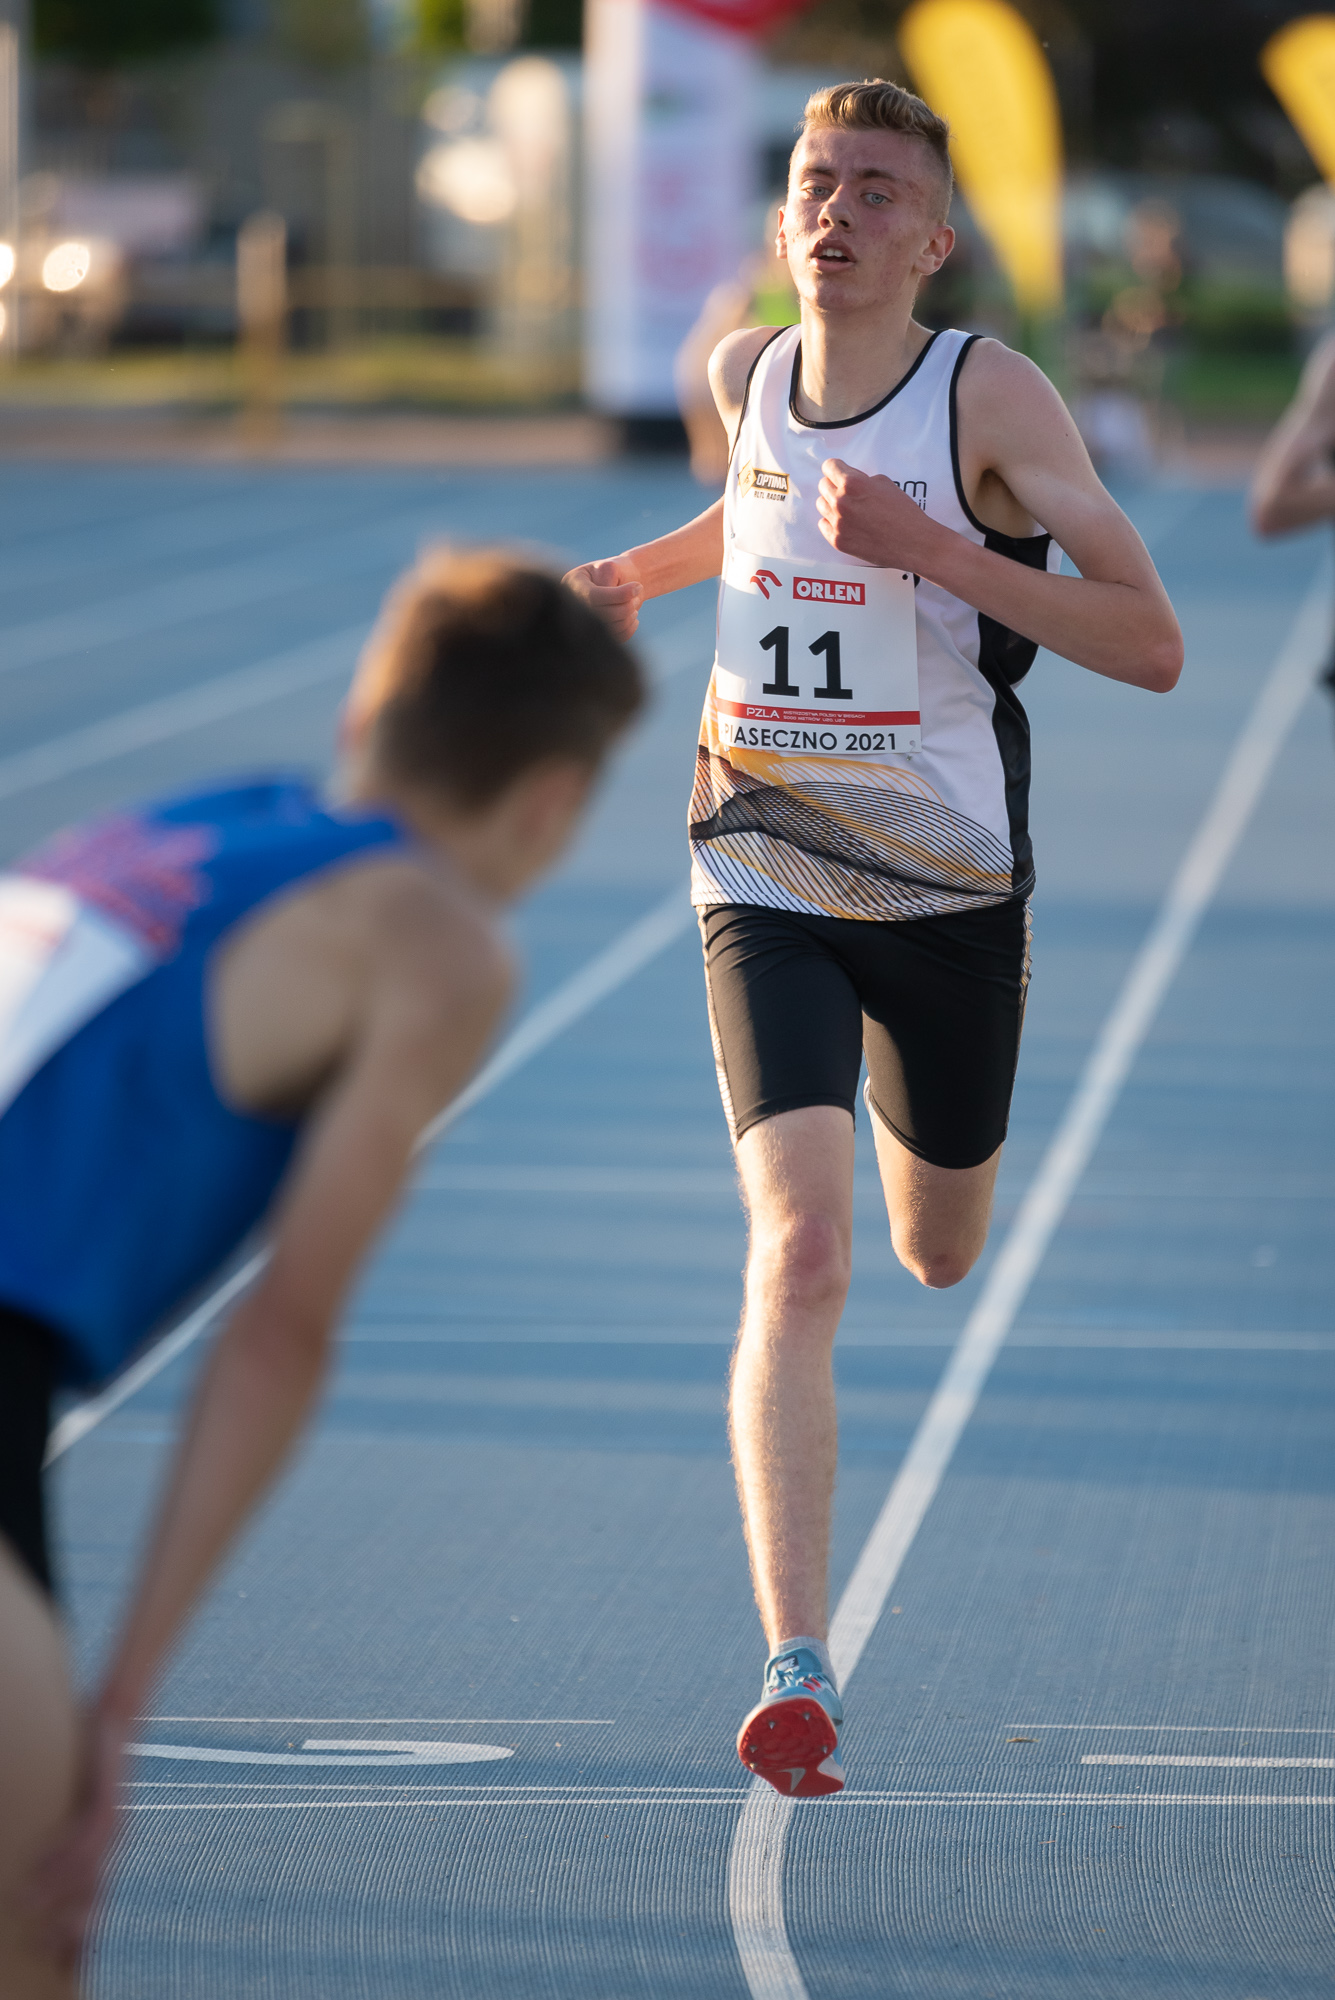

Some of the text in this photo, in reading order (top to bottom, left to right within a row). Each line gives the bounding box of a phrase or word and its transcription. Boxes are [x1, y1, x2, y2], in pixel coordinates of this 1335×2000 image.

[756, 473, 788, 490] OPTIMA
[766, 492, 786, 502] RADOM
[796, 580, 862, 602] ORLEN
[758, 625, 853, 700] 11
[746, 707, 780, 719] PZLA
[845, 732, 896, 751] 2021
